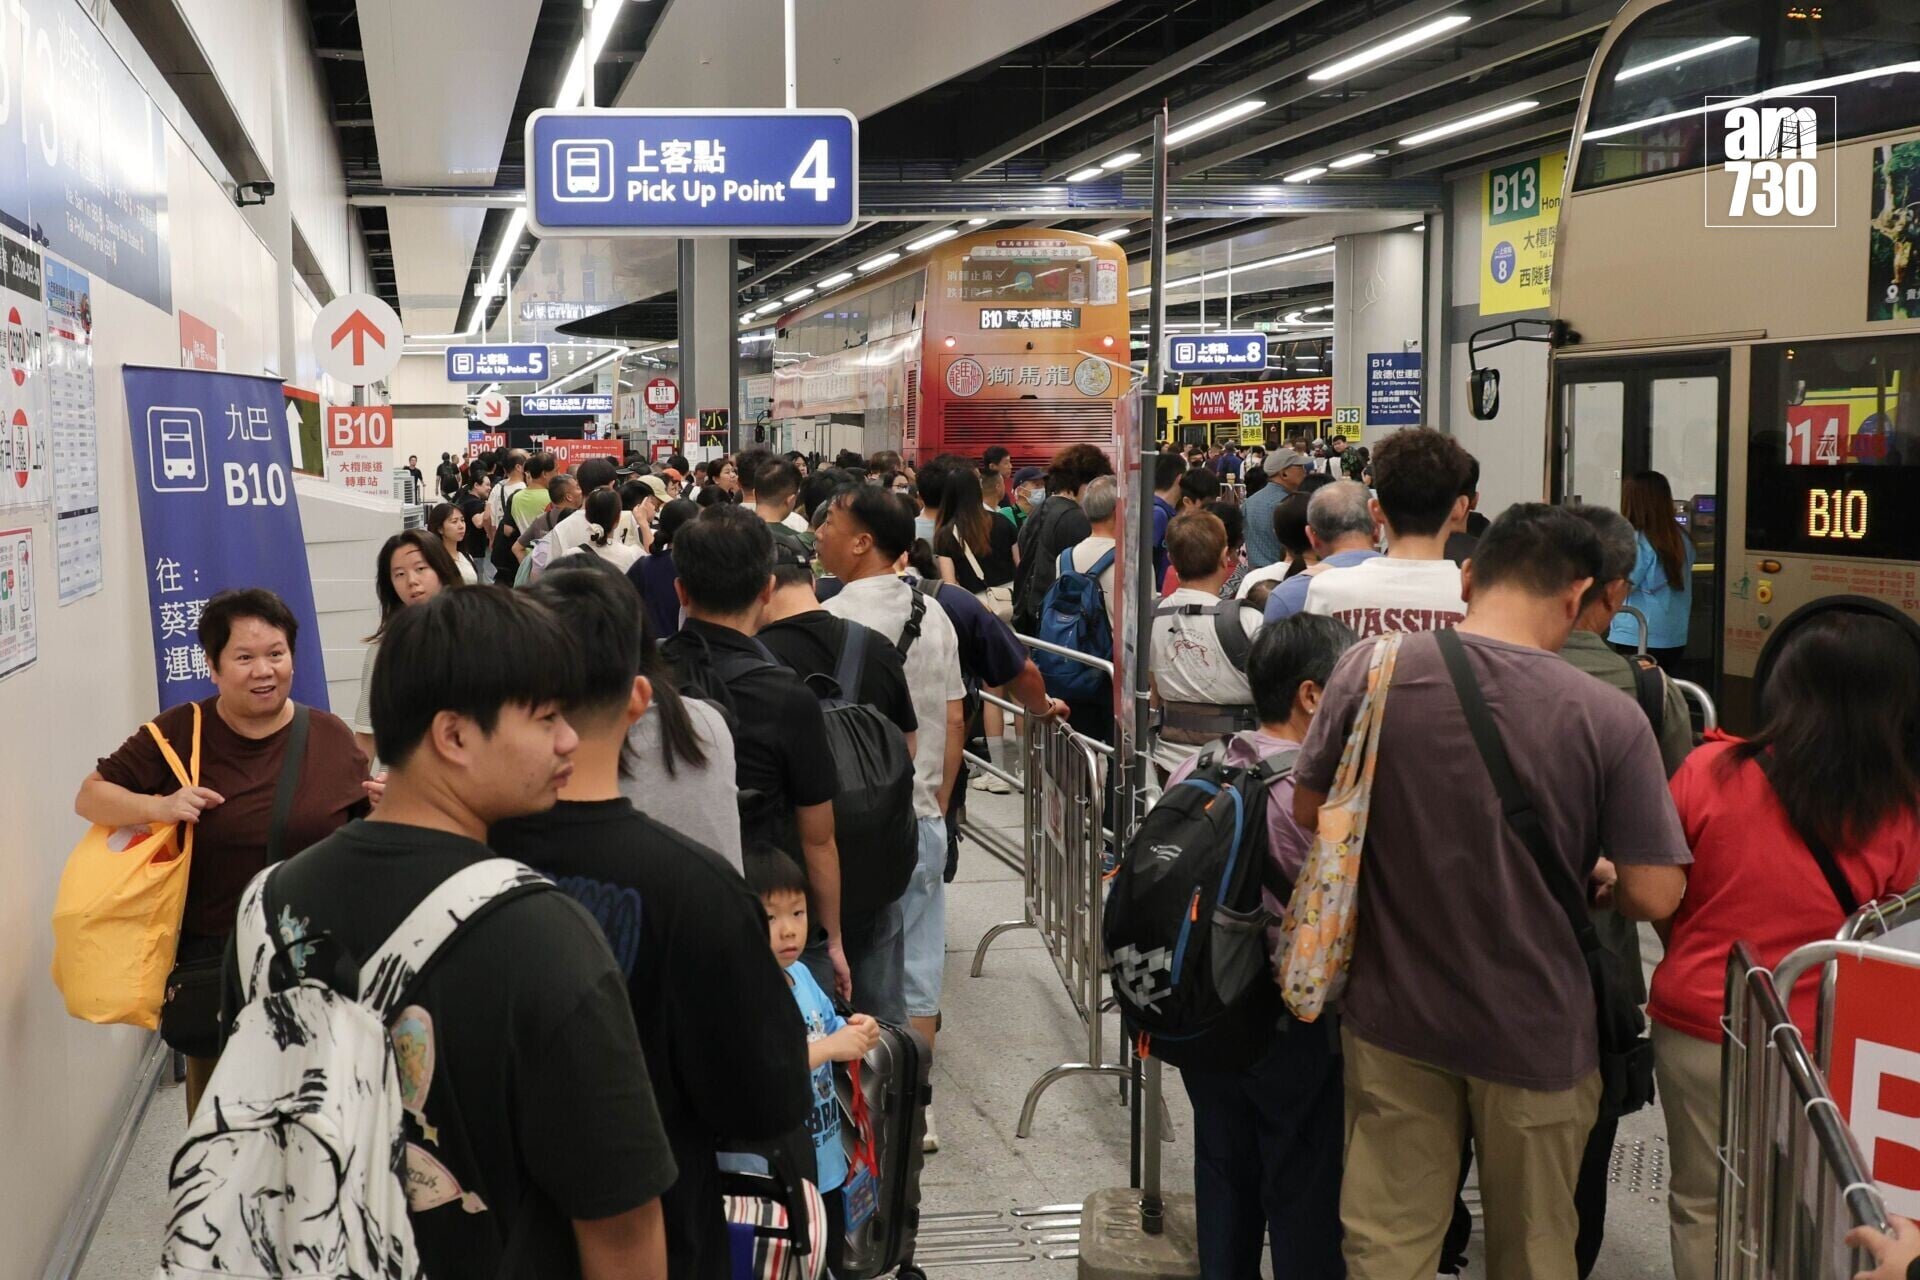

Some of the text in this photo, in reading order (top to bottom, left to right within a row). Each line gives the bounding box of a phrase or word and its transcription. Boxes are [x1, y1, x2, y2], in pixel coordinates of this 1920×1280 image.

[627, 139, 836, 202] 上客點 4
[627, 179, 786, 208] Pick Up Point
[1493, 167, 1536, 216] B13
[1499, 260, 1507, 280] 8
[981, 310, 1003, 329] B10
[1197, 354, 1247, 365] Pick Up Point
[1247, 342, 1261, 362] 8
[476, 366, 528, 376] Pick Up Point
[528, 353, 543, 374] 5
[1372, 359, 1393, 368] B14
[987, 365, 1074, 387] 獅馬龍
[1192, 391, 1226, 406] MAIYA
[1228, 384, 1330, 414] 睇牙 就係麥芽
[225, 403, 272, 440] 九巴
[1243, 413, 1261, 427] B13
[1337, 409, 1359, 423] B13
[334, 412, 386, 445] B10
[686, 422, 697, 441] B11
[1242, 428, 1262, 438] 香港島
[1336, 424, 1360, 435] 香港島
[340, 461, 383, 473] 大欖隧道
[223, 462, 287, 506] B10
[345, 476, 378, 488] 轉車站
[1808, 489, 1868, 539] B10
